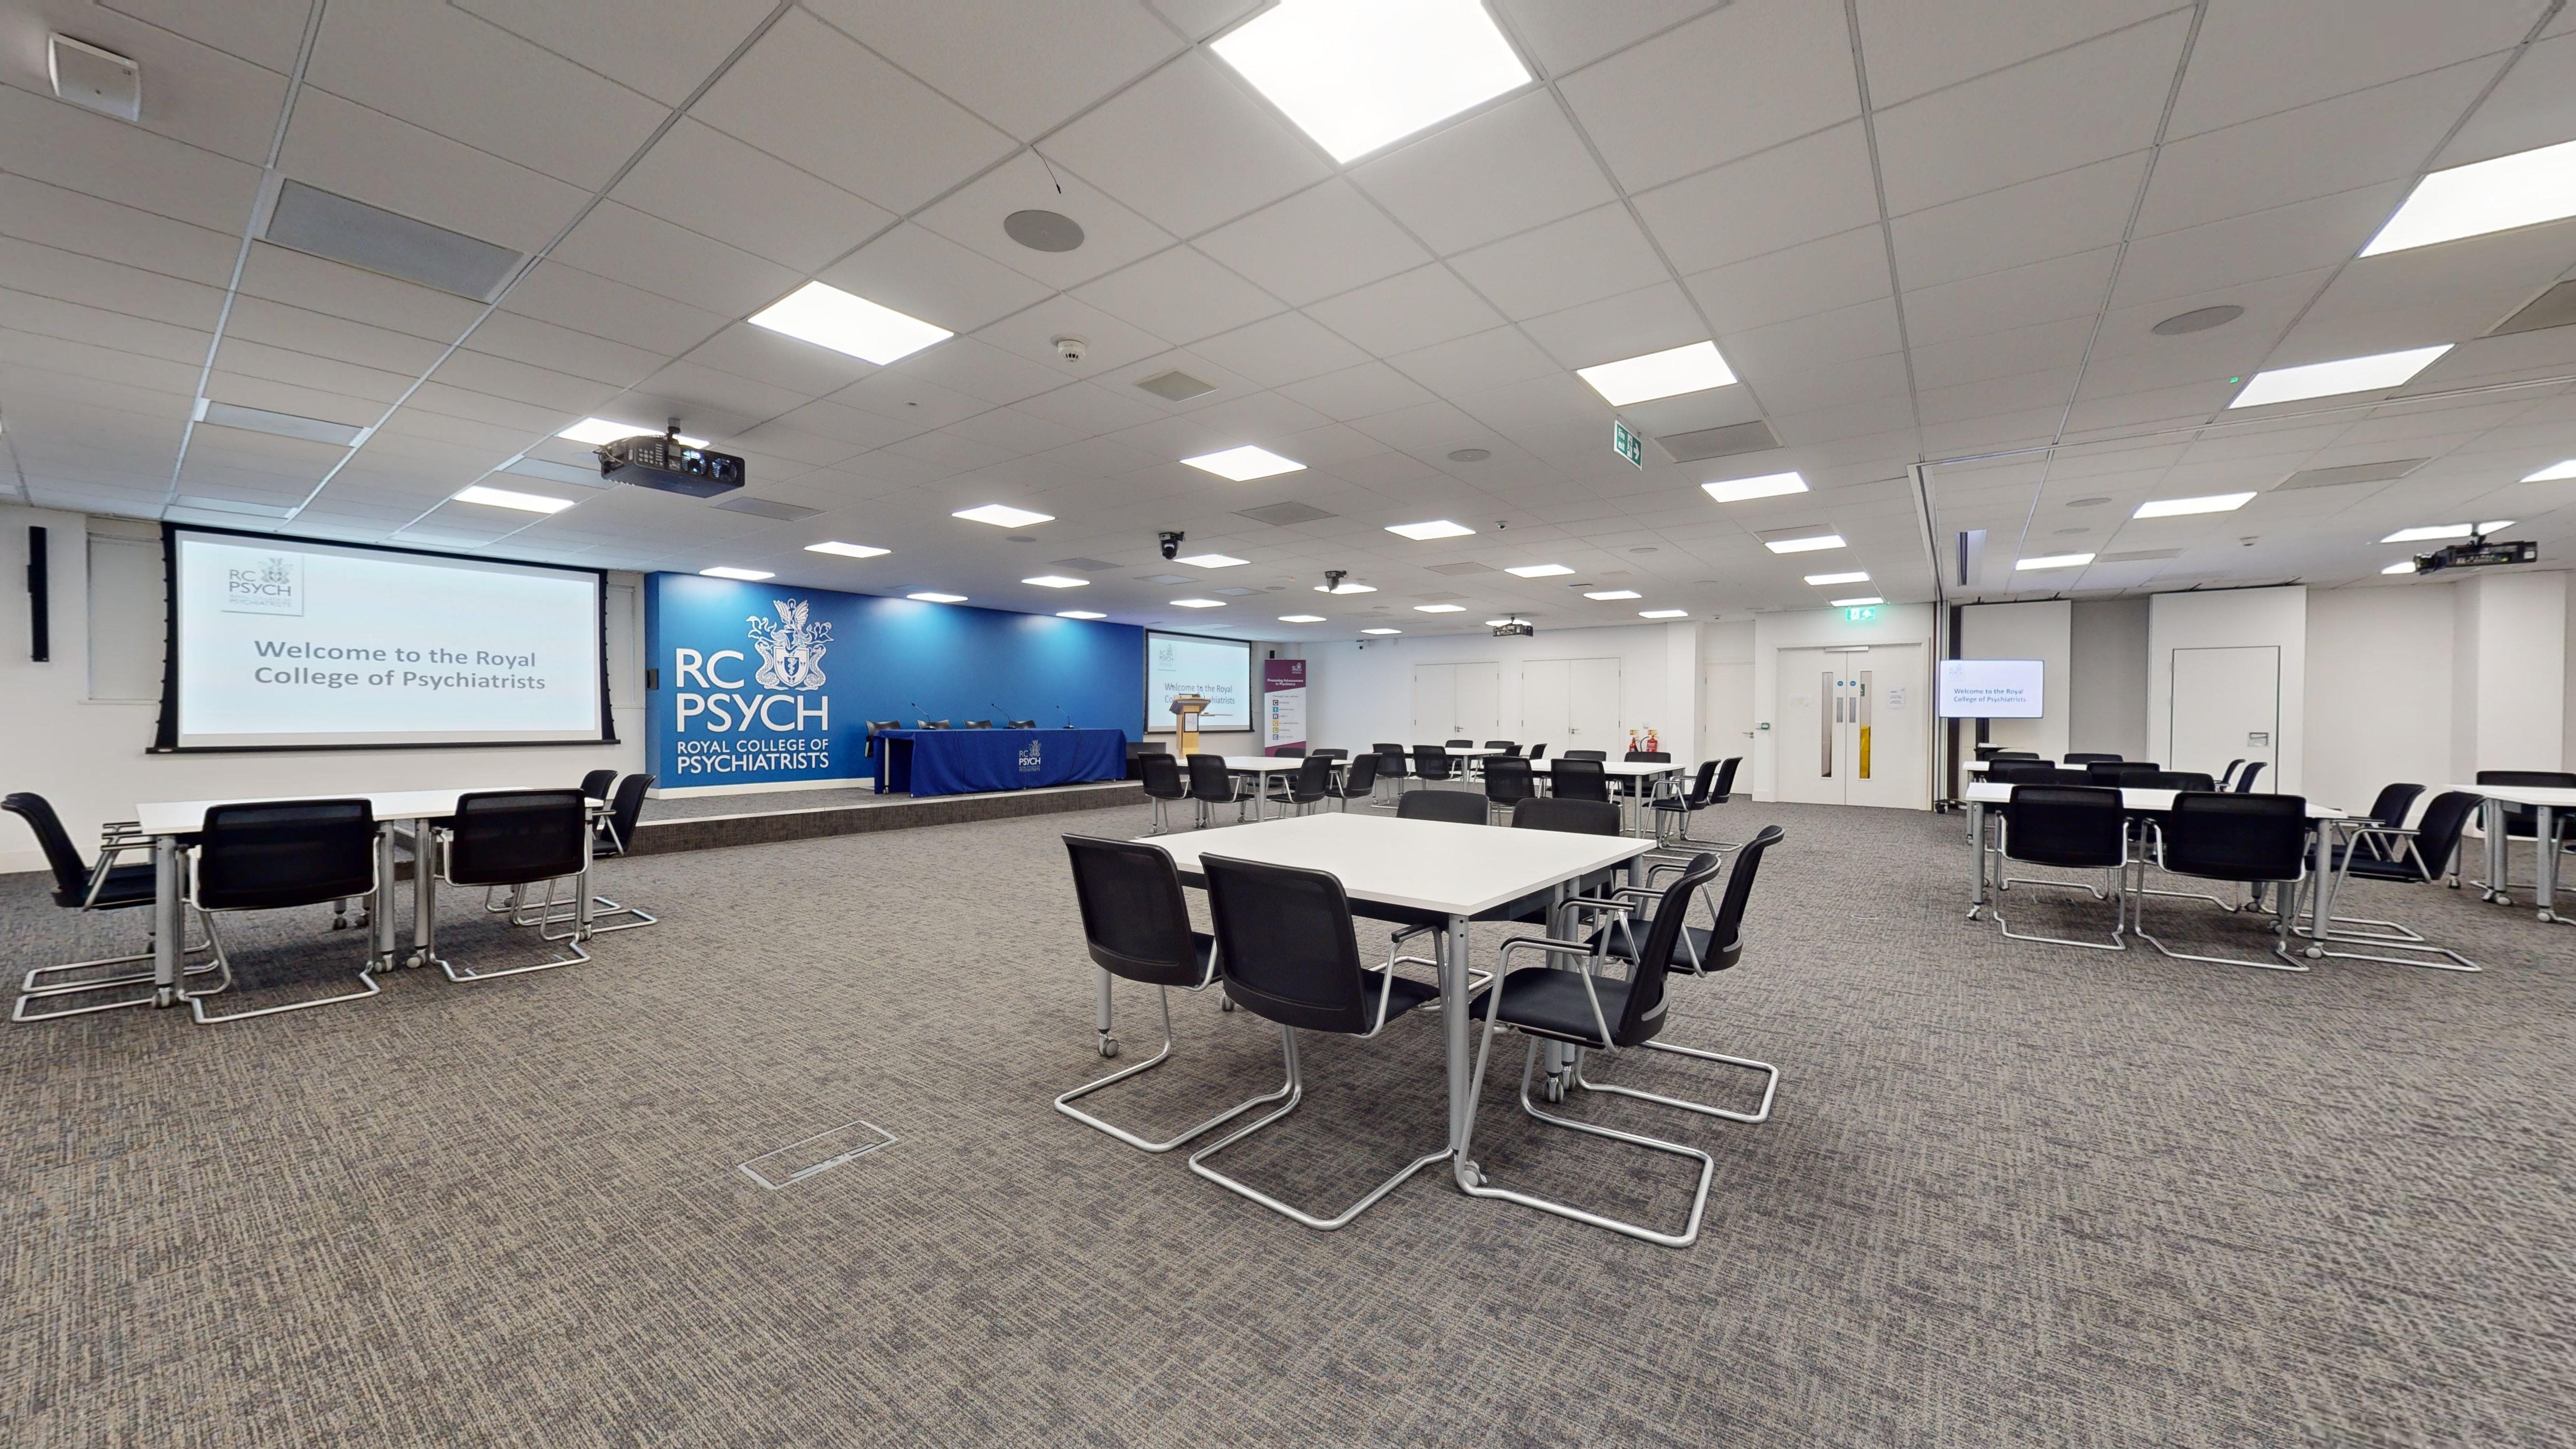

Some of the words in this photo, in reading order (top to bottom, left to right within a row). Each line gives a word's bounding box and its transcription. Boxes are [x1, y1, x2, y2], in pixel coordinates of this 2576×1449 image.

[229, 569, 256, 582] RC
[229, 581, 291, 597] PSYCH
[254, 640, 386, 661] Welcome
[395, 648, 420, 662] to
[428, 648, 468, 665] the
[477, 651, 535, 669] Royal
[676, 648, 745, 689] RC
[254, 667, 359, 689] College
[368, 670, 395, 686] of
[403, 671, 545, 690] Psychiatrists
[1165, 683, 1195, 691] Welcome
[1217, 685, 1232, 694] Royal
[676, 693, 829, 733] PSYCH
[677, 740, 730, 754] ROYAL
[736, 739, 805, 752] COLLEGE
[810, 738, 829, 751] OF
[677, 752, 829, 774] PSYCHIATRISTS
[1019, 757, 1041, 766] PSYCH
